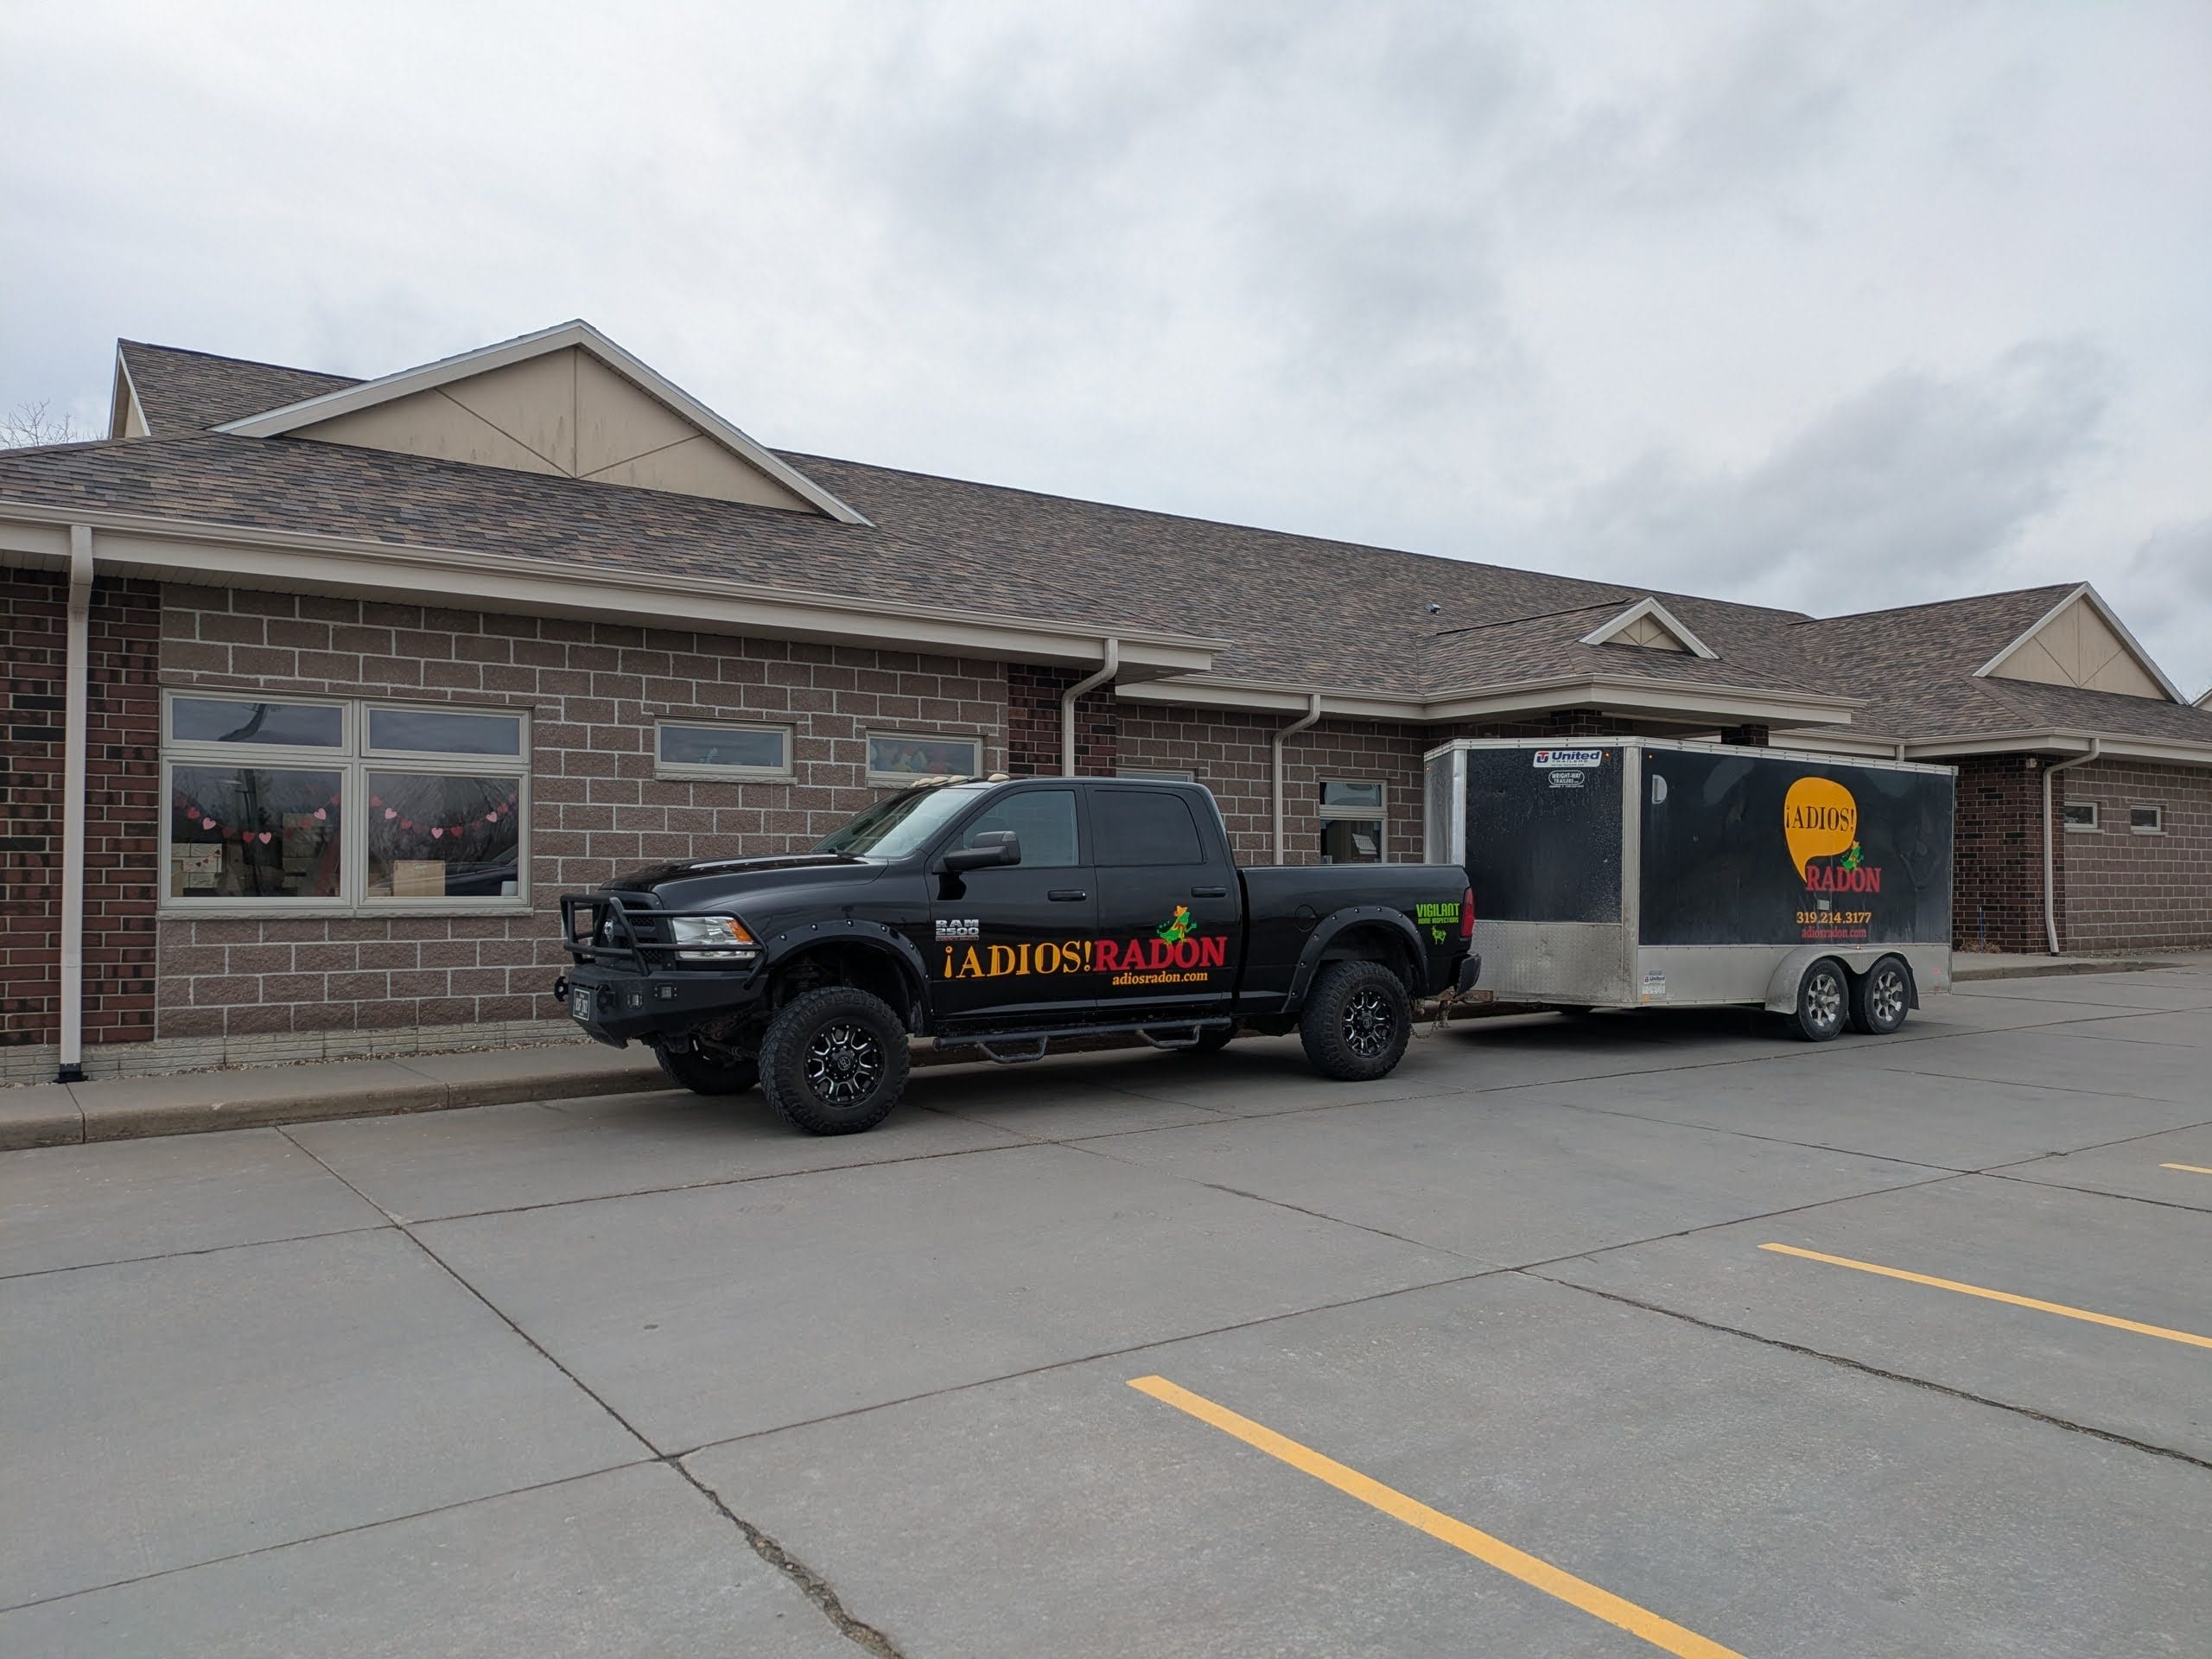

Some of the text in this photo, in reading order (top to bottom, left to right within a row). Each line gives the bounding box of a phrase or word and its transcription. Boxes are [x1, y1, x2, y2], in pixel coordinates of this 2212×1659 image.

[1806, 865, 1882, 893] RADON
[1416, 903, 1459, 917] VIGILANT
[936, 919, 979, 928] RAM
[1796, 912, 1872, 924] 319.214.3177
[936, 927, 979, 936] 2500
[1802, 925, 1867, 938] adiosradon.com
[1093, 938, 1228, 972] RADON
[1111, 970, 1209, 986] adiosradon.com
